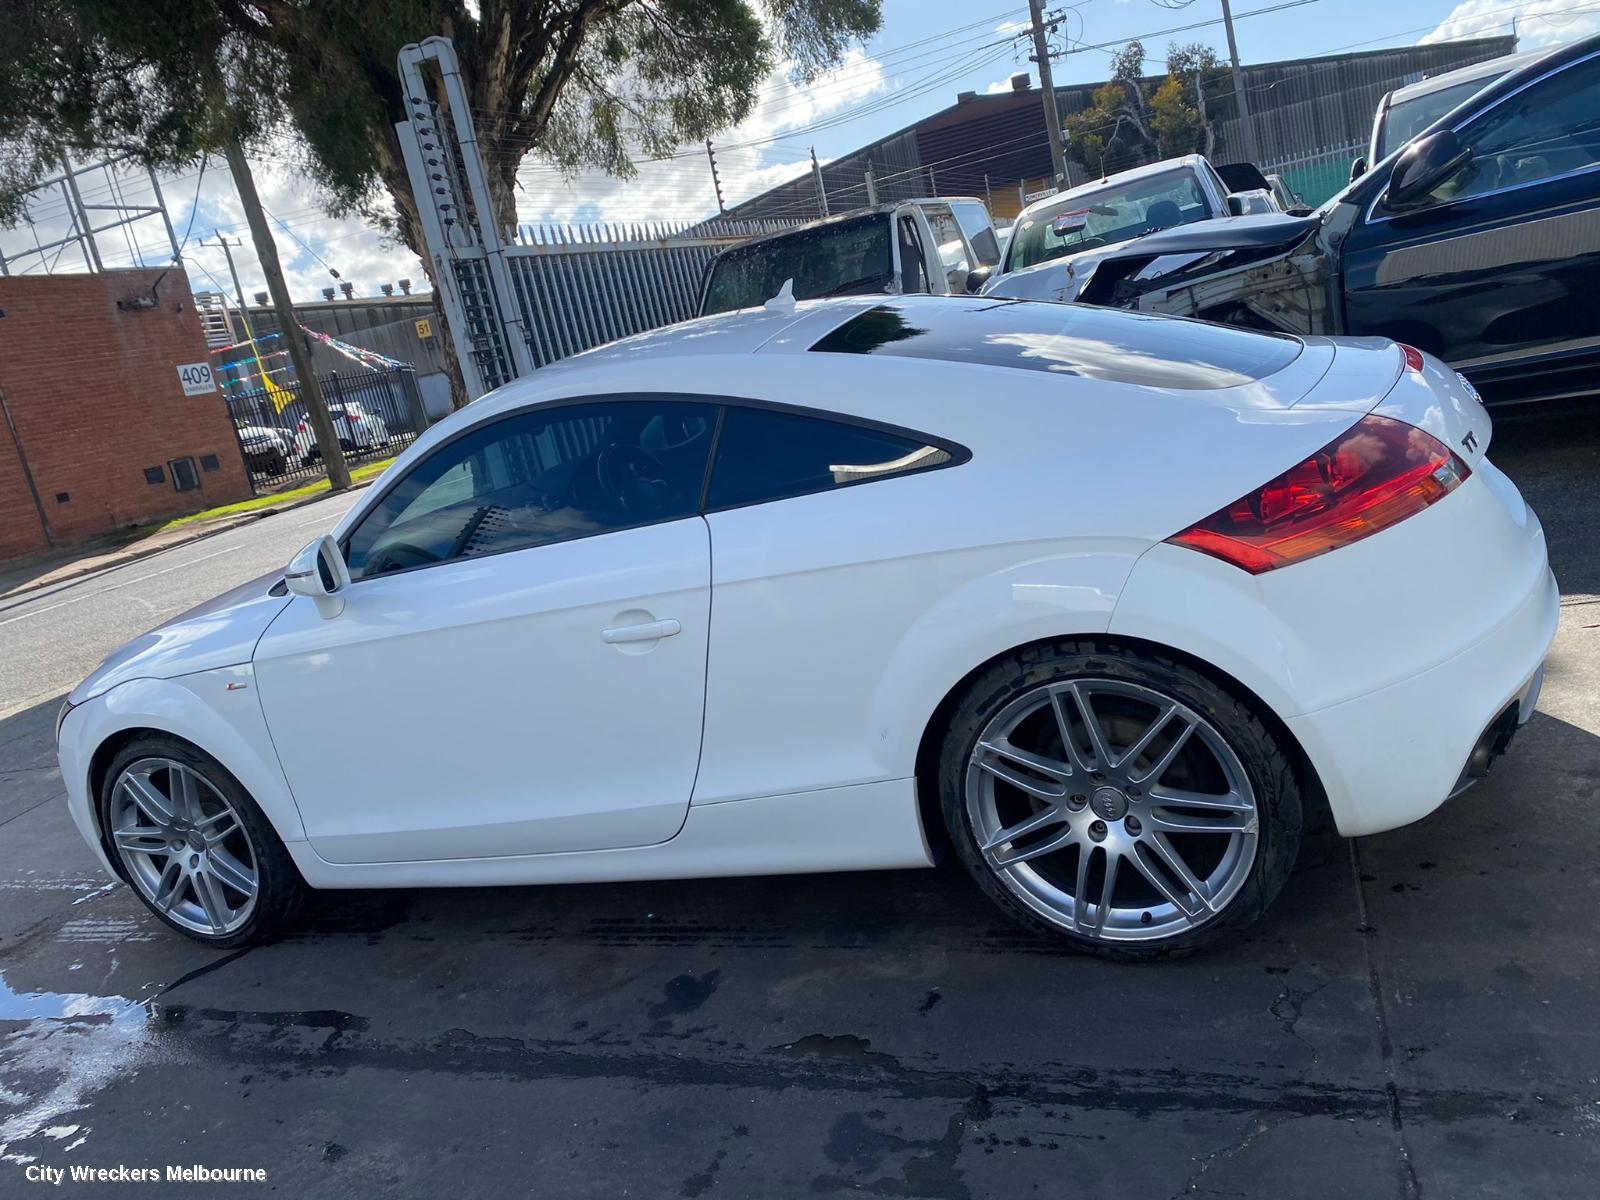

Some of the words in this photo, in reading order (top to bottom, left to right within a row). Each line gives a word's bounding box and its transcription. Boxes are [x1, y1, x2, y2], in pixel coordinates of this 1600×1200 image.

[418, 323, 429, 334] 51
[182, 366, 210, 385] 409
[1461, 430, 1478, 453] TT
